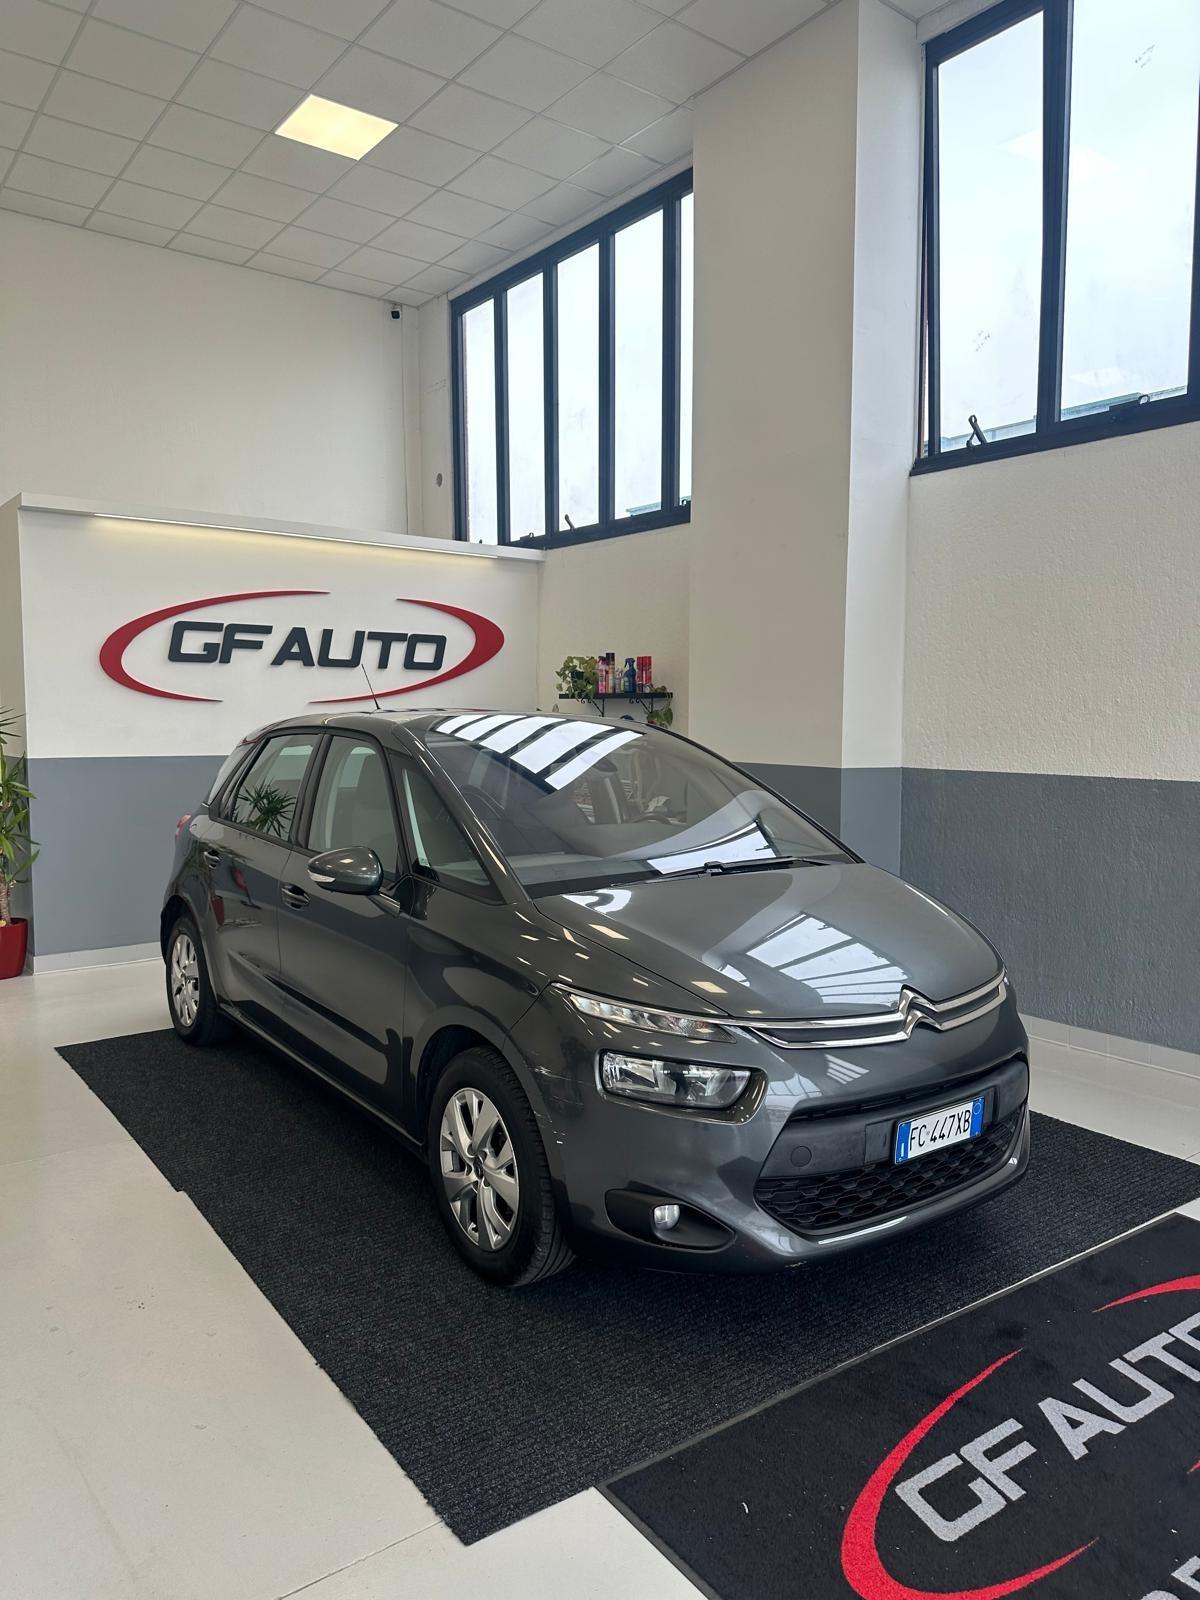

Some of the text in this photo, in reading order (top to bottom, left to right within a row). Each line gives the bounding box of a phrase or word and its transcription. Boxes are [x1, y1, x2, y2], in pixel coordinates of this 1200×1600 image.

[168, 621, 447, 670] GF AUTO
[895, 1417, 1037, 1542] GF
